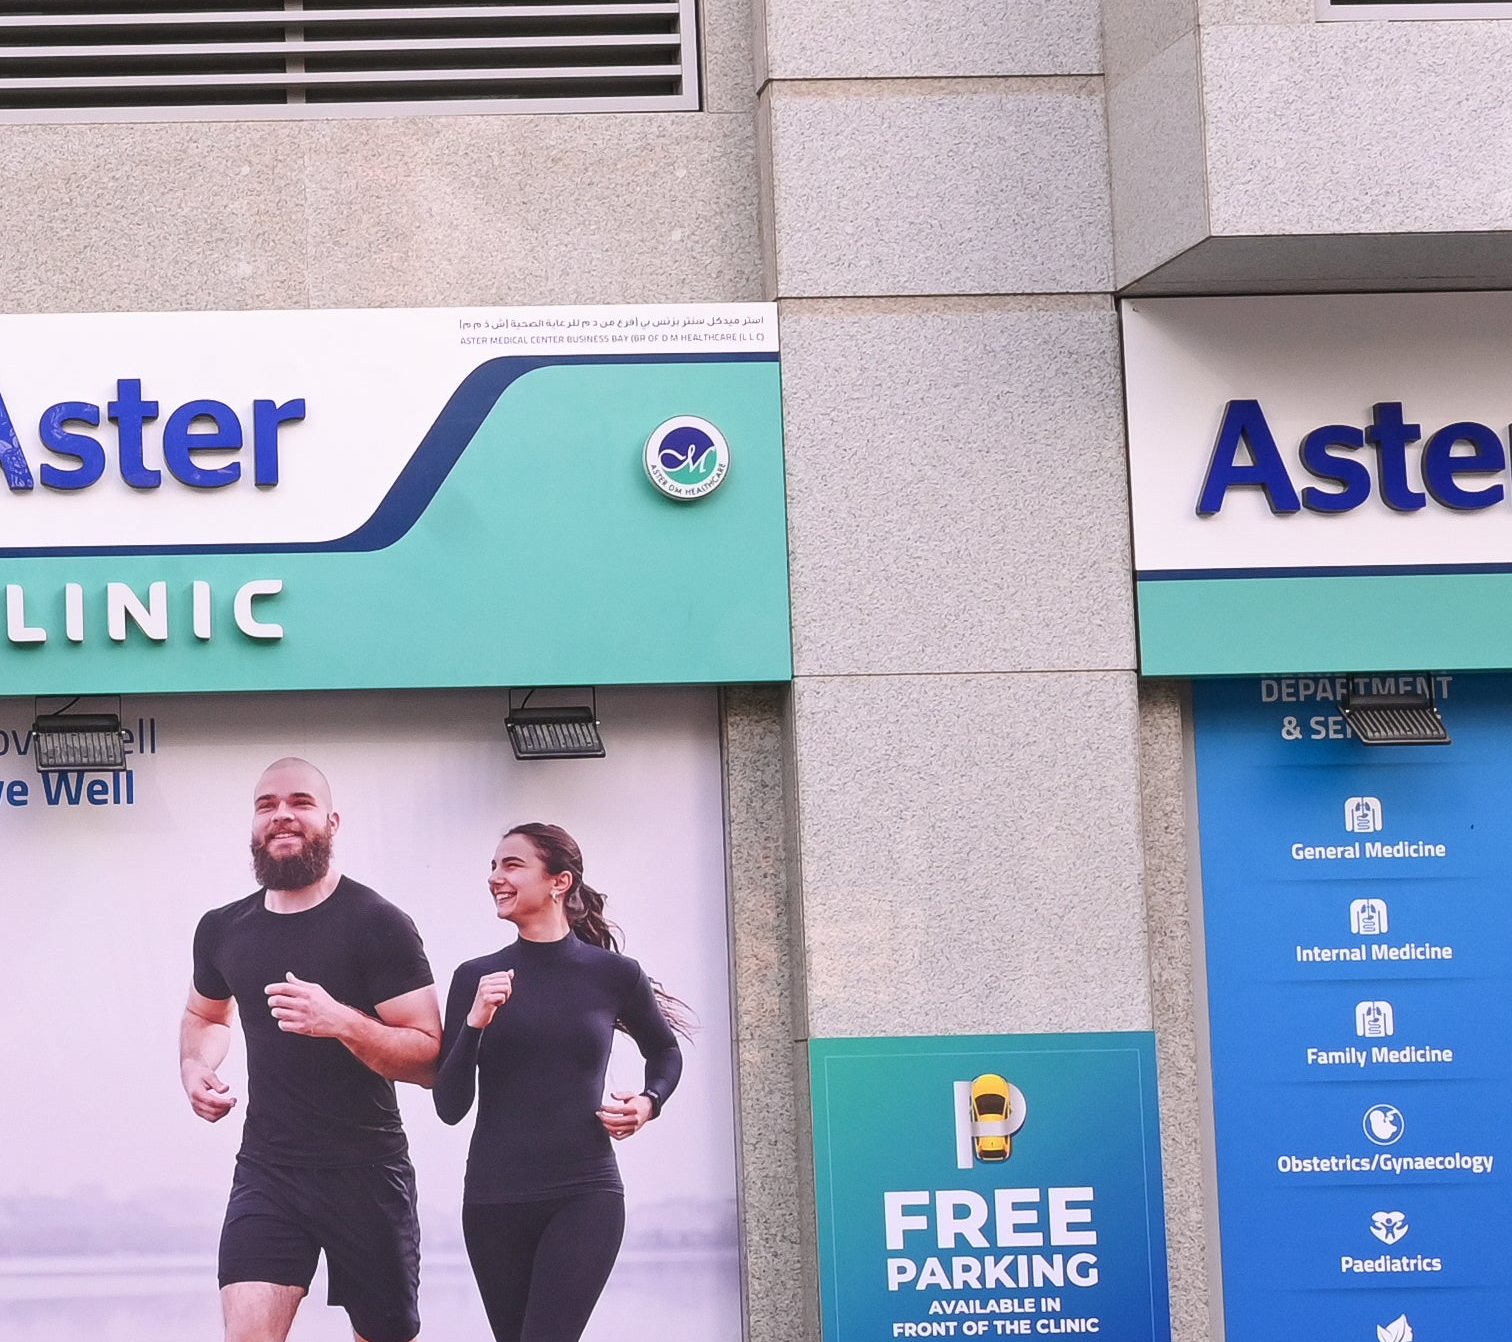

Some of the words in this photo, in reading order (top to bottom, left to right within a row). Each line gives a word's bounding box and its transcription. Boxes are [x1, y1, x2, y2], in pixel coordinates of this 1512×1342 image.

[460, 336, 488, 345] ASTER
[490, 335, 529, 345] MEDICAL
[530, 335, 565, 344] CENTER
[567, 334, 609, 344] BUSINESS
[612, 334, 629, 343] BAY
[630, 333, 646, 344] (BR
[648, 333, 659, 343] OF
[661, 333, 669, 342] D
[670, 333, 678, 342] M
[680, 332, 737, 342] HEALTHCARE
[650, 464, 668, 487] ASTER
[668, 484, 682, 495] DM
[685, 463, 727, 495] HEALTHCARE
[1281, 716, 1303, 741] &
[40, 770, 134, 806] Well
[1291, 842, 1361, 861] General
[1365, 841, 1446, 859] Medicine
[1296, 944, 1367, 962] Internal
[1371, 943, 1453, 961] Medicine
[1307, 1047, 1367, 1068] Family
[1372, 1046, 1453, 1064] Medicine
[1277, 1153, 1494, 1174] Obstetrics/Gynaecology
[883, 1186, 1098, 1250] FREE
[886, 1253, 1100, 1291] PARKING
[1341, 1255, 1442, 1273] Paediatrics
[928, 1298, 1036, 1315] AVAILABLE
[1040, 1297, 1061, 1313] IN
[892, 1321, 956, 1338] FRONT
[961, 1320, 989, 1336] OF
[993, 1319, 1031, 1335] THE
[1036, 1317, 1100, 1334] CLINIC
